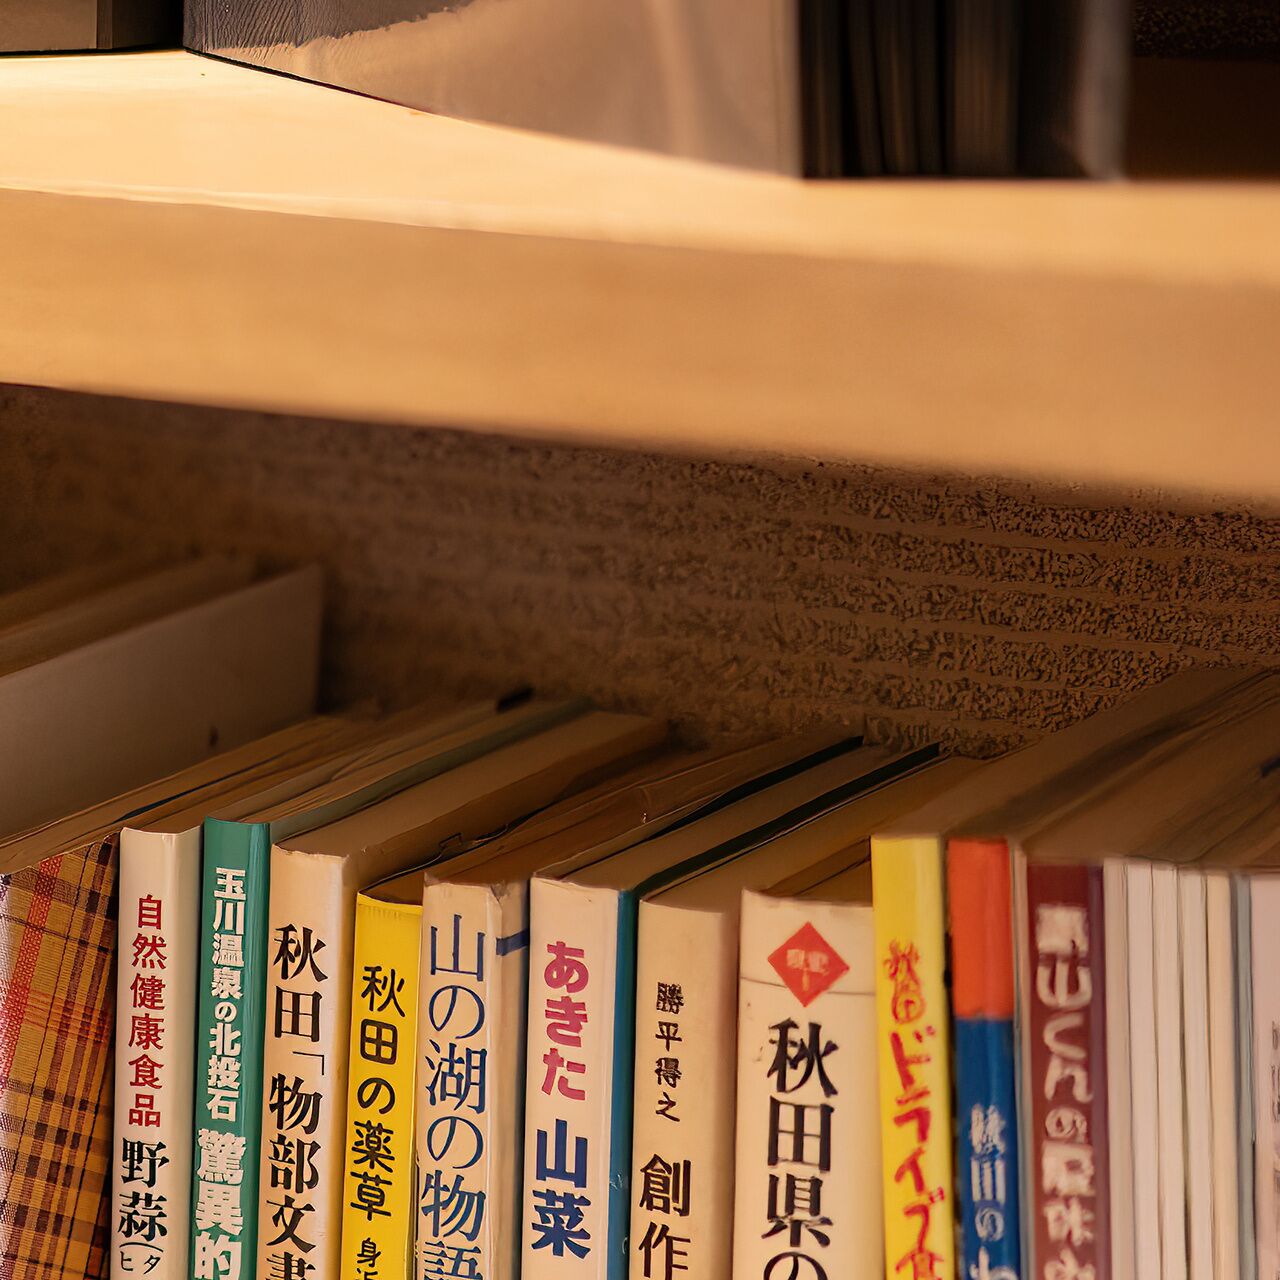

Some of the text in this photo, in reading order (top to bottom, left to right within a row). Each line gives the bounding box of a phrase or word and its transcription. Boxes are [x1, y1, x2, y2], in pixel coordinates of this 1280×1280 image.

[127, 894, 166, 1129] 自然健康食品
[205, 865, 247, 1122] 玉川温泉の北投石
[539, 940, 590, 1102] あきた
[654, 982, 684, 1123] 勝平得之
[349, 965, 405, 1223] 秋田の薬草
[530, 1118, 591, 1259] 山菜
